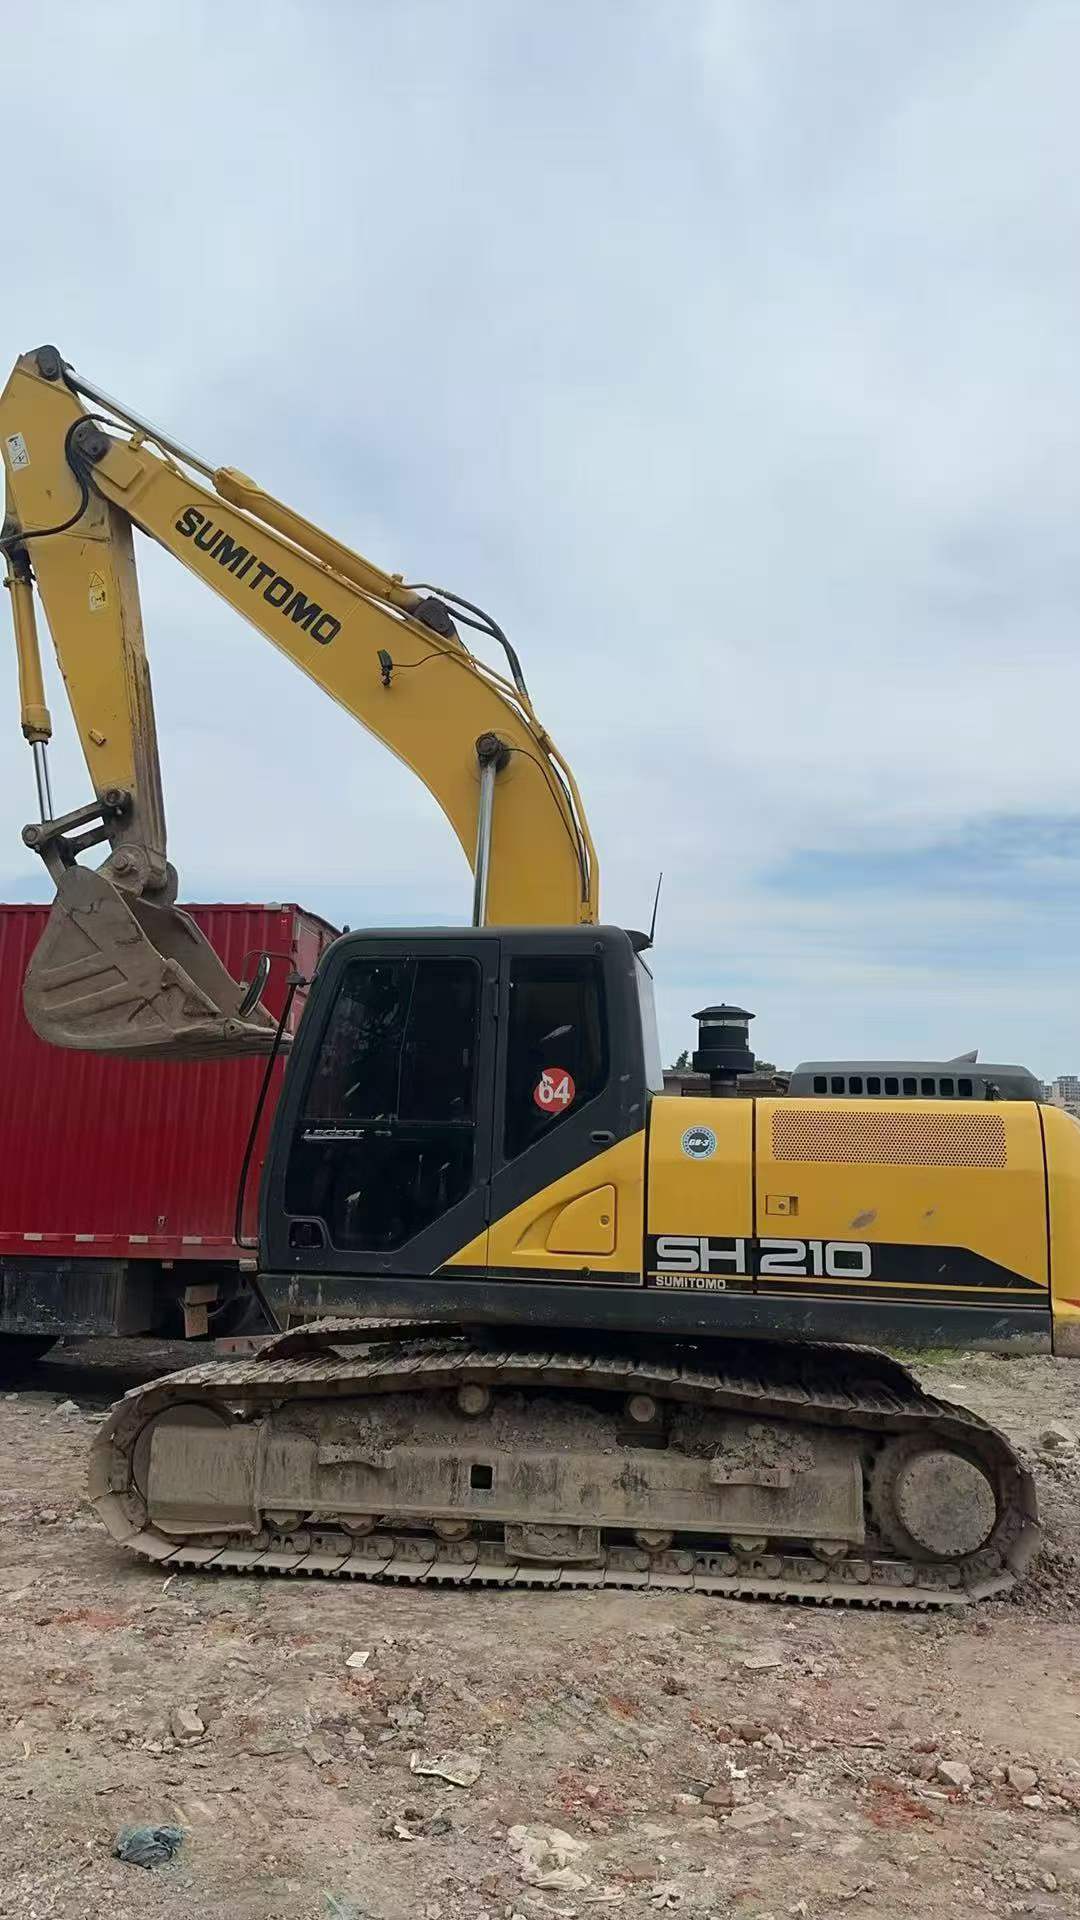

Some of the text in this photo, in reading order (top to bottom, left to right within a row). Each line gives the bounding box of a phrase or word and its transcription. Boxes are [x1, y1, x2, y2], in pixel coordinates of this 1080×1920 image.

[175, 507, 342, 645] SUMITOMO
[539, 1073, 570, 1104] 64
[656, 1236, 872, 1278] SH 210
[655, 1275, 726, 1290] SUMITOMO
